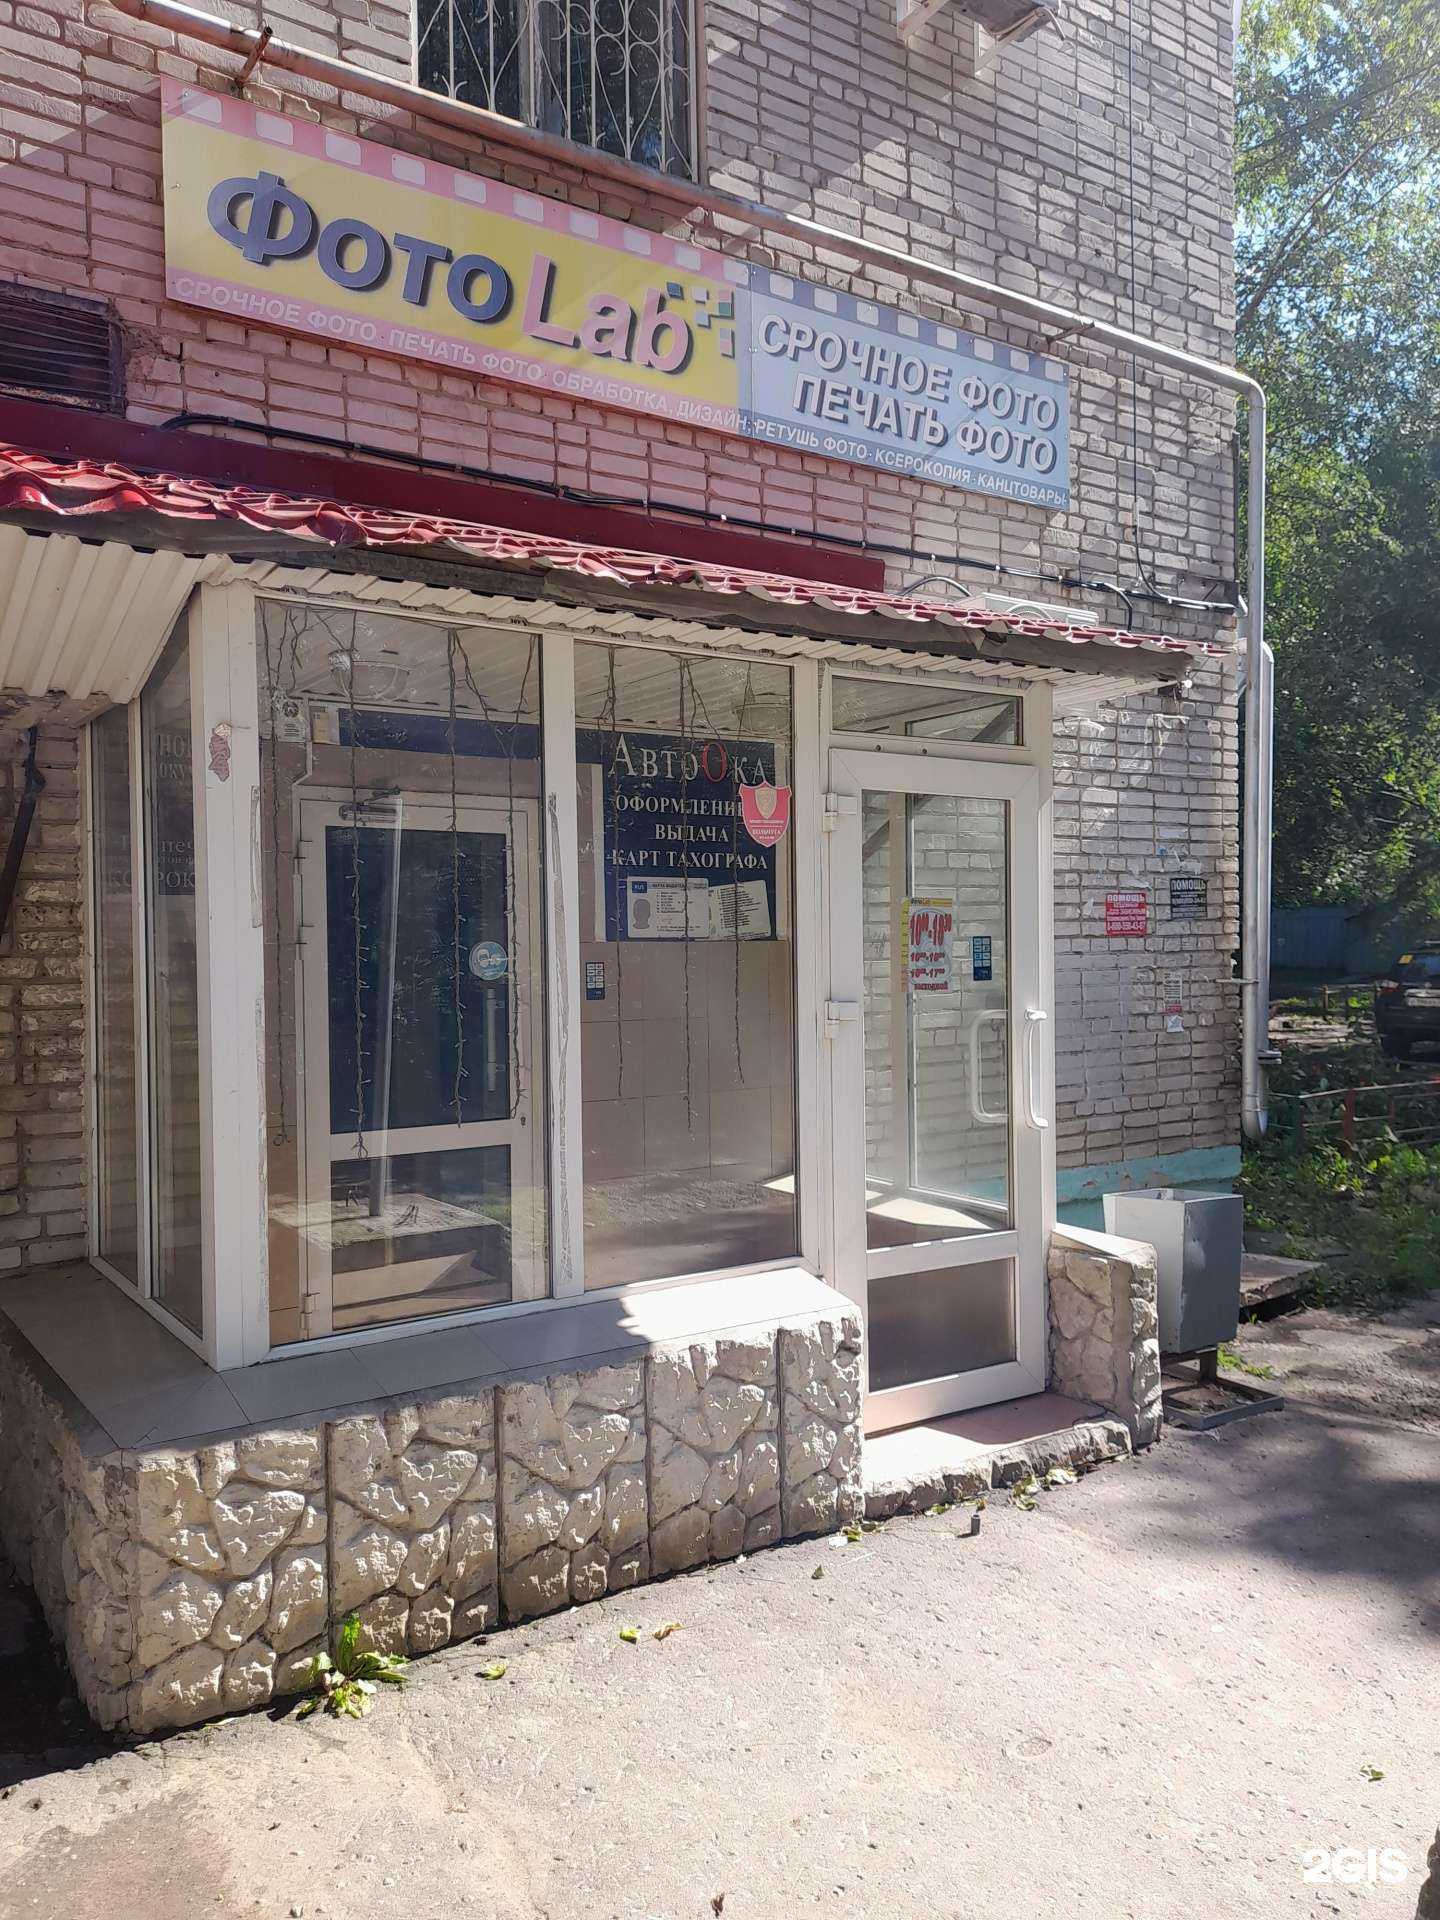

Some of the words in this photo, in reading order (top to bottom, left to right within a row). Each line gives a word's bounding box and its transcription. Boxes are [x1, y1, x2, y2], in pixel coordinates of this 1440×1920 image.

[176, 278, 300, 323] СРОЧНОЕ
[307, 311, 377, 341] ФОТО
[388, 329, 475, 363] ПЕЧАТЬ
[482, 352, 544, 381] ФОТО
[755, 419, 819, 447] РЕТУШЬ
[823, 437, 868, 458] ФОТО
[875, 449, 971, 483] КСЕРОКОПИЯ
[758, 314, 952, 404] СРОЧНОЕ
[958, 376, 1058, 430] ФОТО
[793, 373, 948, 447] ПЕЧАТЬ
[956, 420, 1057, 474] ФОТО
[655, 824, 729, 842] ВЫДАЧА
[612, 850, 661, 867] КАРТ
[667, 851, 768, 869] ТАХОГРАФА
[1171, 879, 1206, 891] ПОМОЩЬ
[1107, 894, 1145, 902] ПОМОЩЬ
